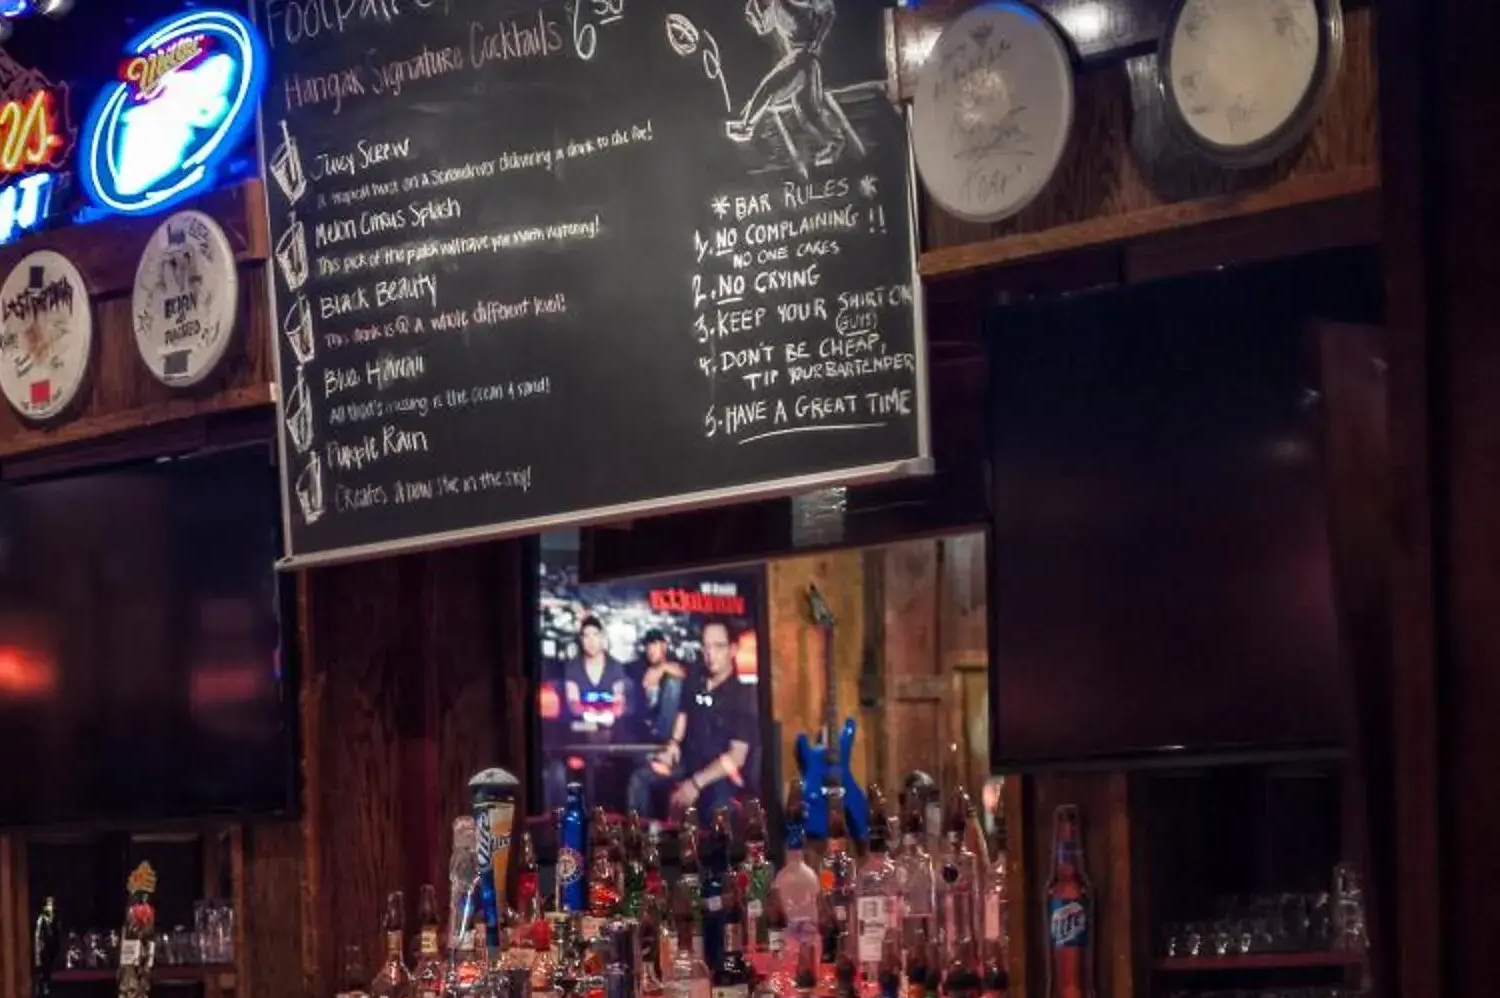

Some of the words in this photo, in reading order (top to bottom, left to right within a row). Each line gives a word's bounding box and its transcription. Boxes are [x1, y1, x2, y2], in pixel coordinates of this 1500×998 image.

[735, 193, 772, 221] BAR
[782, 177, 850, 209] RULES
[716, 227, 738, 250] NO
[745, 203, 860, 246] COMPLAINING
[733, 252, 753, 270] NO
[757, 246, 789, 265] ONE
[321, 289, 370, 320] Black
[376, 273, 438, 312] Beauty
[718, 273, 746, 298] NO
[754, 263, 821, 294] CRYING
[716, 308, 767, 339] KEEP
[776, 297, 828, 324] YOUR
[837, 285, 885, 312] SHIRT
[720, 341, 775, 372] DON'T
[785, 341, 811, 363] BE
[742, 369, 779, 392] TIP
[787, 362, 823, 386] YOUR
[824, 352, 916, 379] BARTENDER
[725, 400, 768, 435] HAVE
[772, 399, 789, 425] A
[795, 394, 859, 420] GREAT
[864, 385, 913, 416] TIME
[383, 424, 429, 458] Rain
